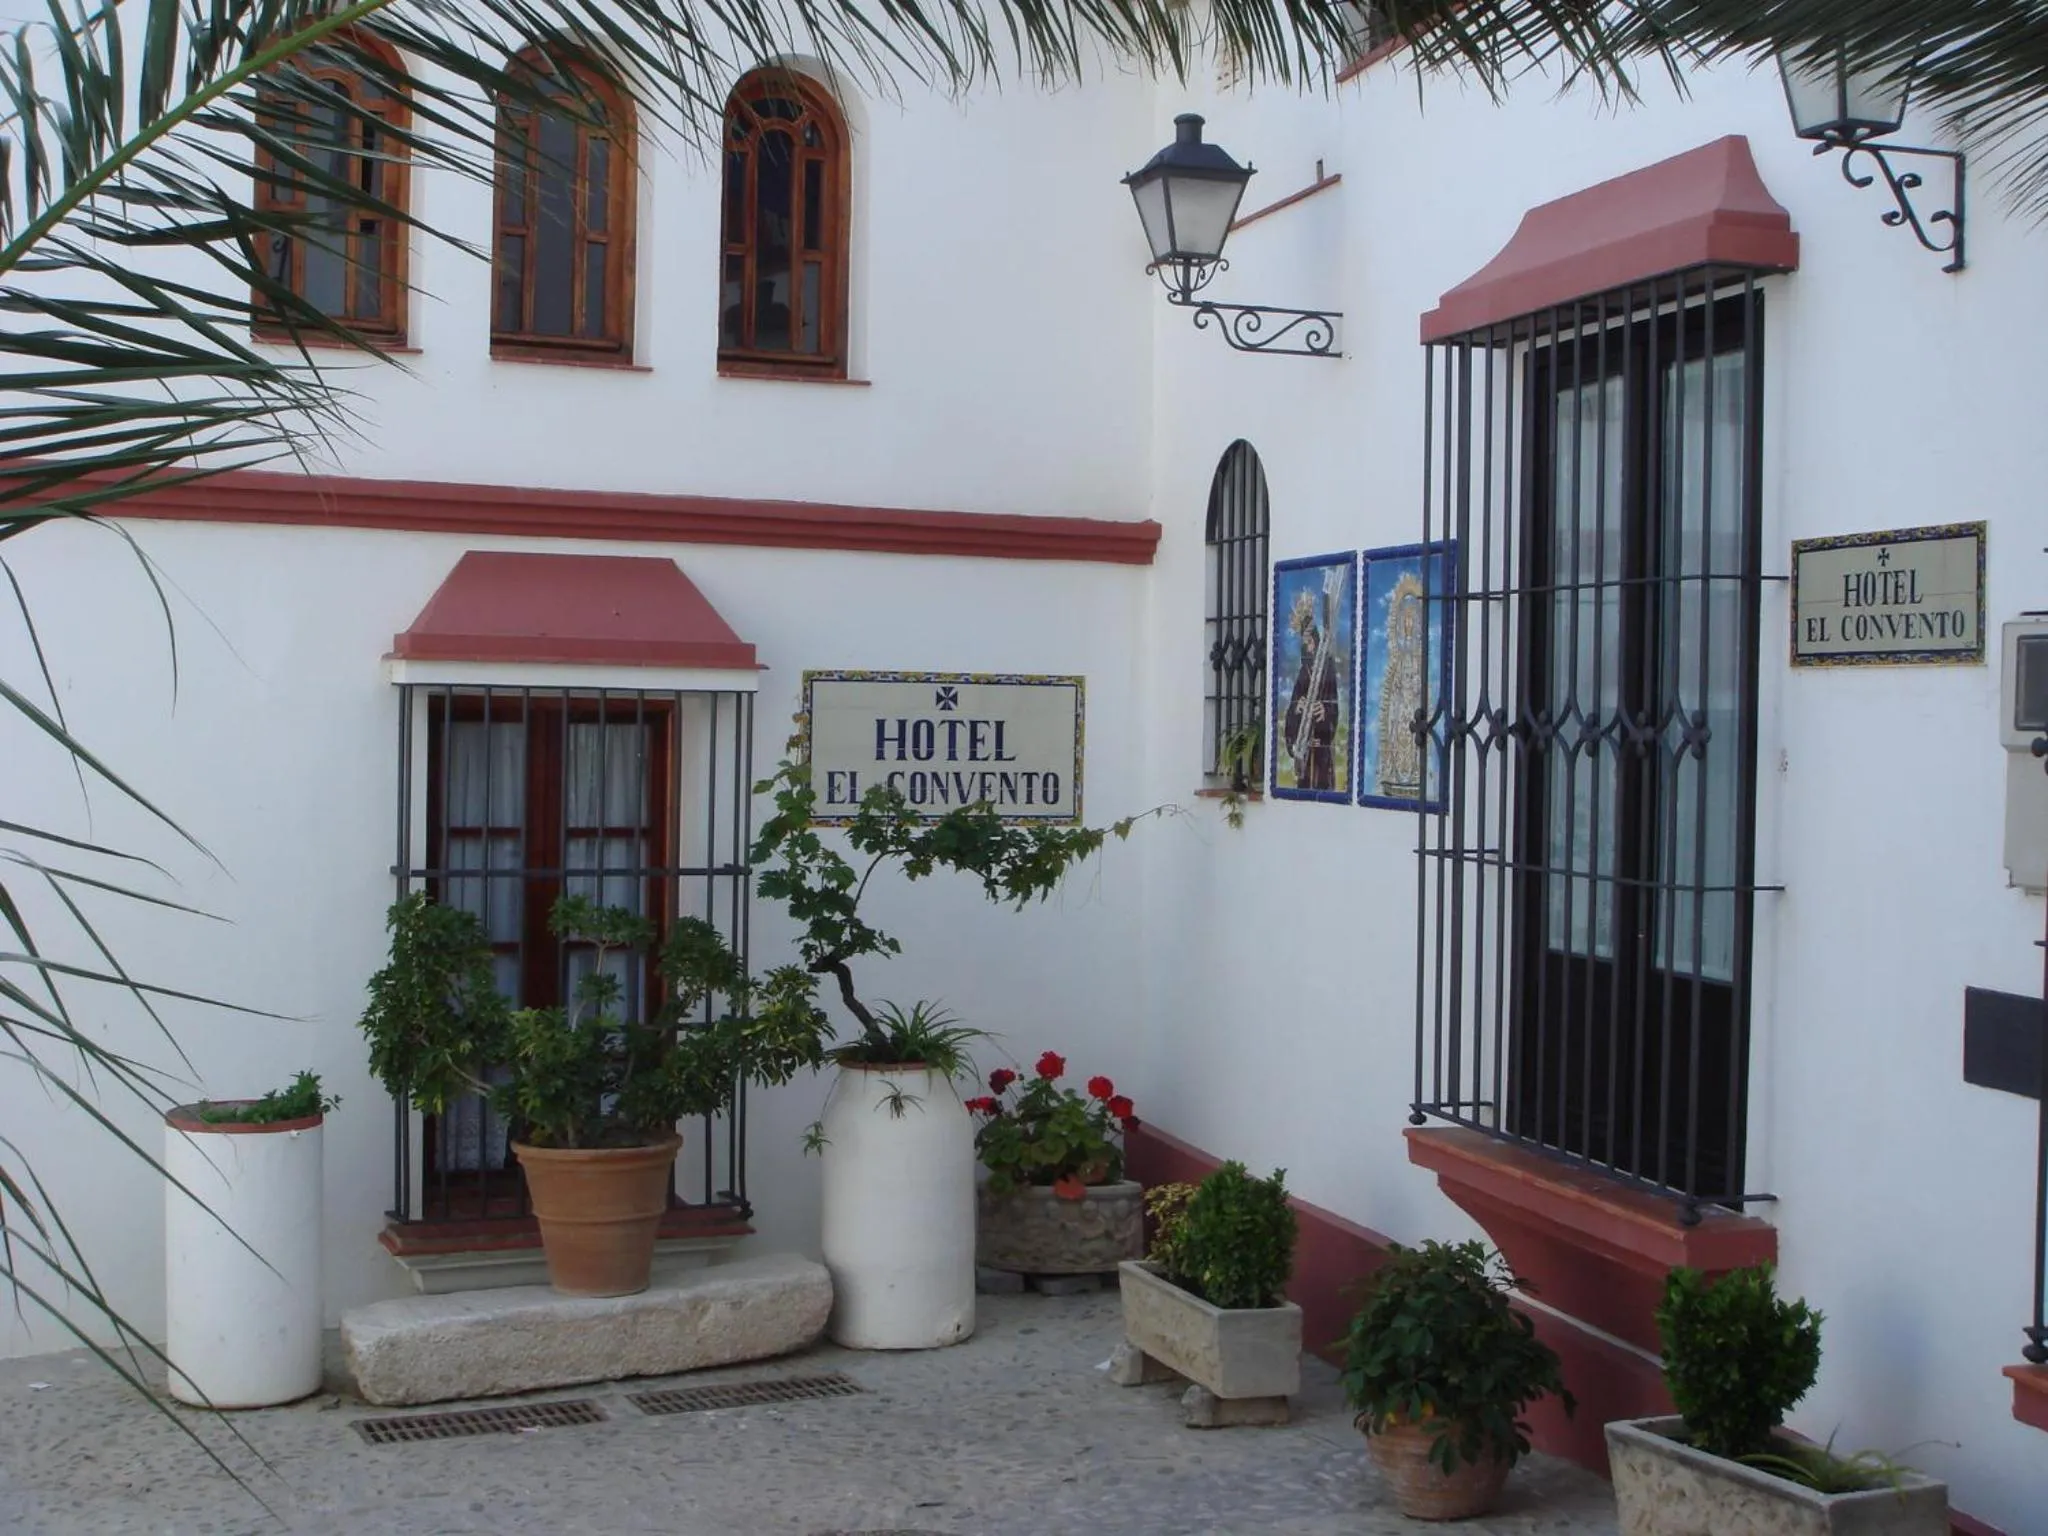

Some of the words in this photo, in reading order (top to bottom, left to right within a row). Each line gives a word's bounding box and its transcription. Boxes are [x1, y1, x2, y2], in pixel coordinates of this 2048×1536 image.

[1842, 568, 1924, 608] HOTEL
[1806, 617, 1831, 643] EL
[1840, 609, 1965, 642] CONVENTO
[874, 718, 1017, 761] HOTEL
[826, 771, 862, 805] EL
